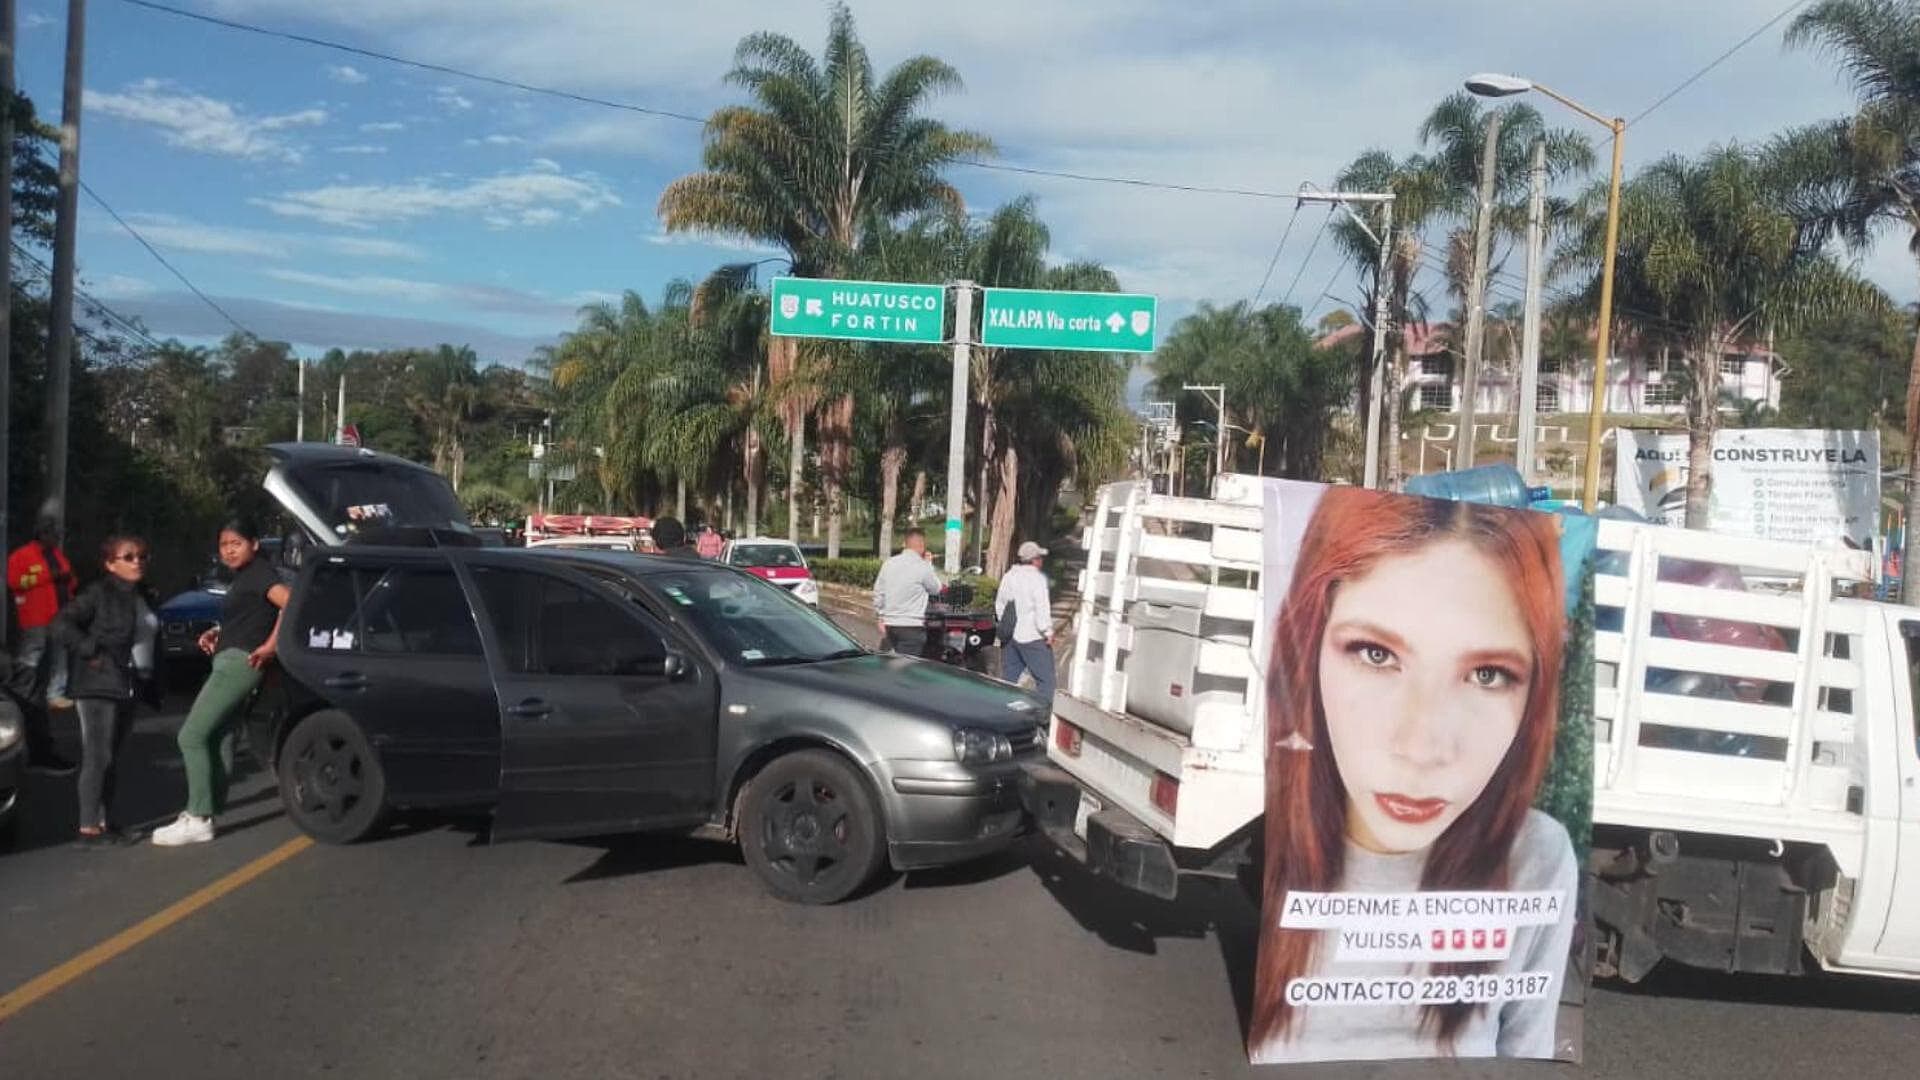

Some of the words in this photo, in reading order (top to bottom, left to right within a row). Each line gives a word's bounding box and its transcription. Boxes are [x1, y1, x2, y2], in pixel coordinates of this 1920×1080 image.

[831, 291, 937, 311] HUATUSCO
[831, 313, 918, 332] FORTIN
[989, 308, 1043, 329] XALAPA
[1713, 448, 1837, 463] CONSTRUYE
[1841, 448, 1868, 464] LA
[1407, 897, 1420, 915] A
[1425, 895, 1542, 915] ENCONTRAR
[1547, 895, 1559, 912] A
[1343, 932, 1422, 950] YULISSA
[1290, 981, 1414, 1001] CONTACTO
[1420, 979, 1457, 1000] 228
[1463, 978, 1498, 998] 319
[1504, 975, 1549, 996] 3187
